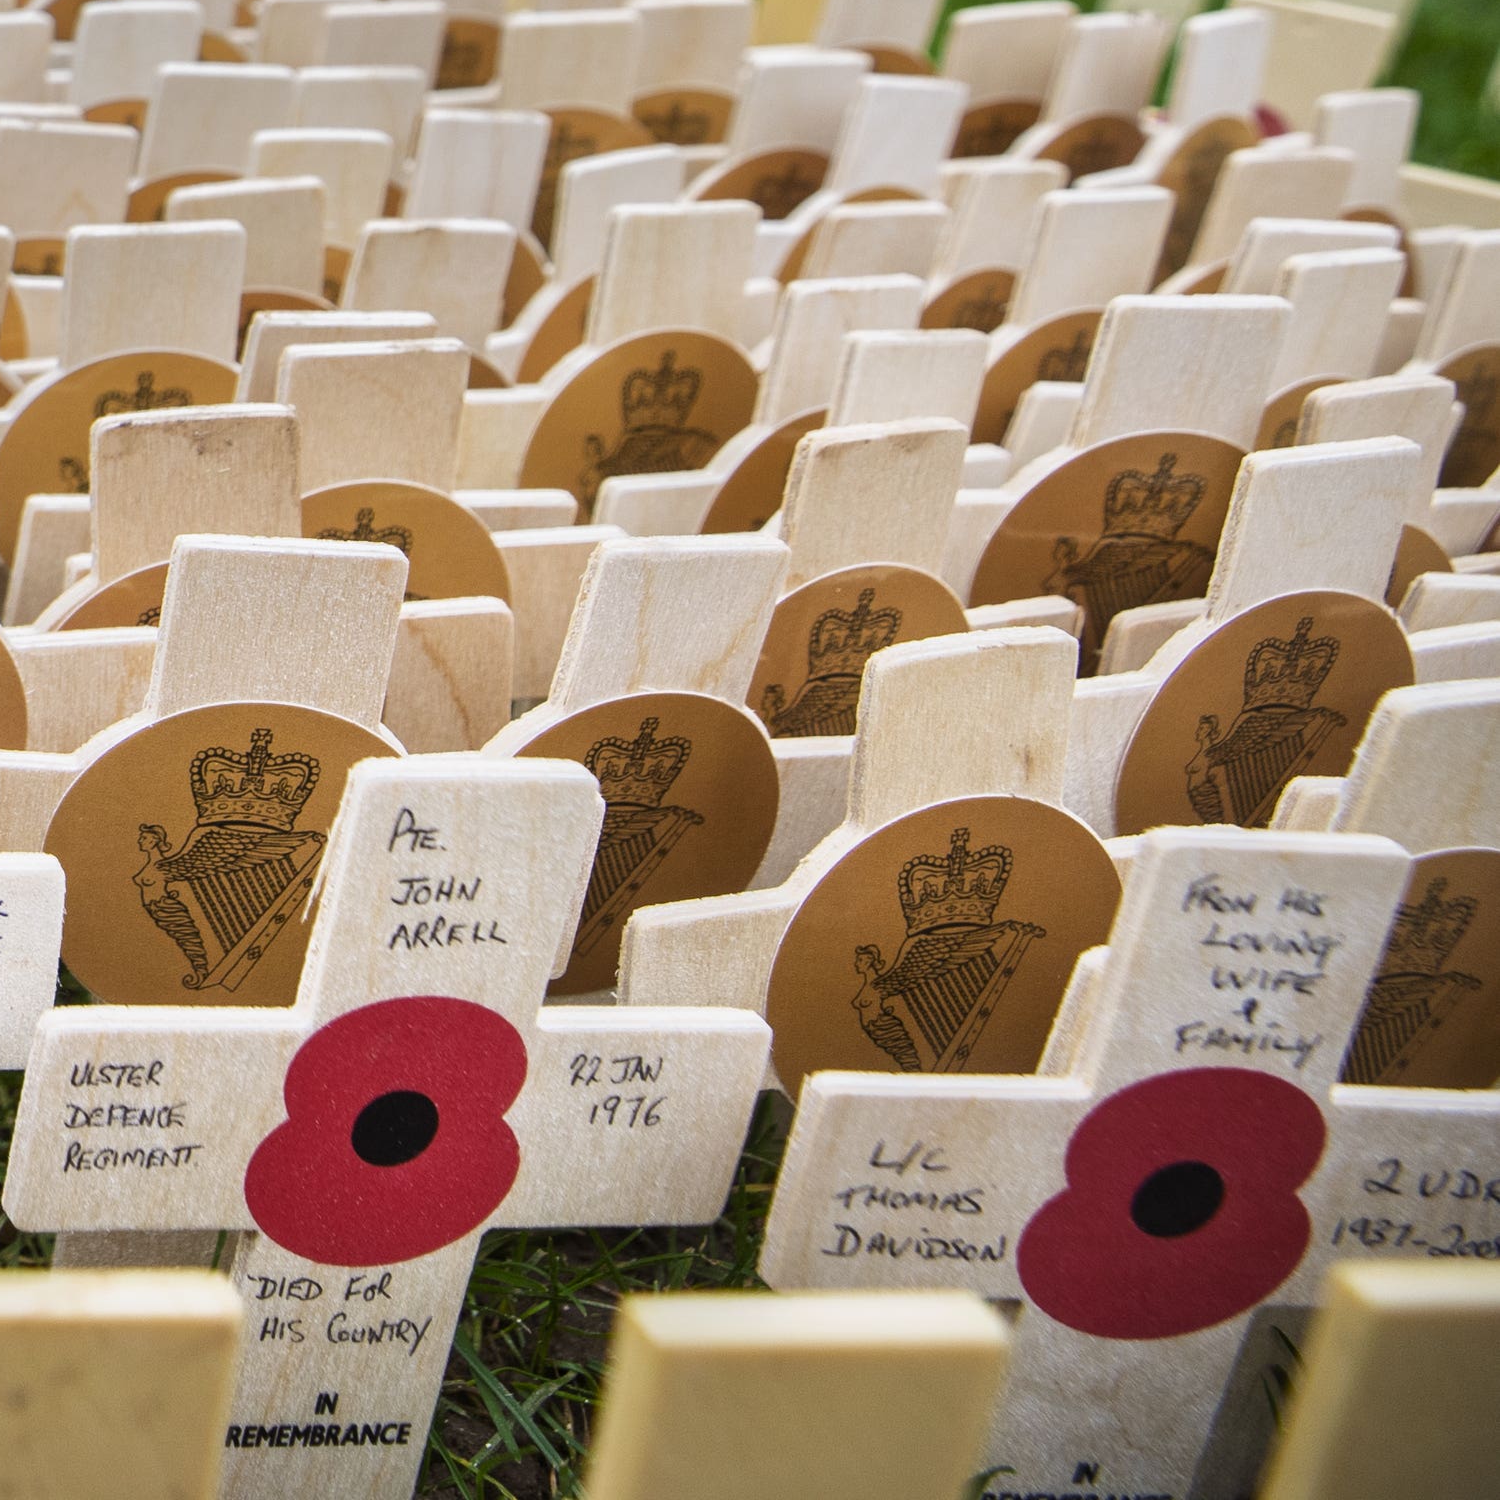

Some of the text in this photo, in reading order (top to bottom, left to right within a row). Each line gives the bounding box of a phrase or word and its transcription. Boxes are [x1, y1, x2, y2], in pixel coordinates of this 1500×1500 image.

[390, 874, 483, 906] JOHN
[388, 915, 509, 951] ARRELL
[70, 1060, 165, 1088] ULSTER
[569, 1052, 664, 1087] 22 JAN
[63, 1101, 188, 1130] DEFENCE
[588, 1094, 669, 1129] 1976
[833, 1183, 987, 1216] THOMAS
[821, 1222, 1008, 1263] DAVIDSON
[246, 1274, 324, 1302] DIED
[258, 1311, 434, 1358] HIS COUNTRY
[314, 1391, 340, 1416] IN
[224, 1421, 413, 1449] REMEMBRANCE
